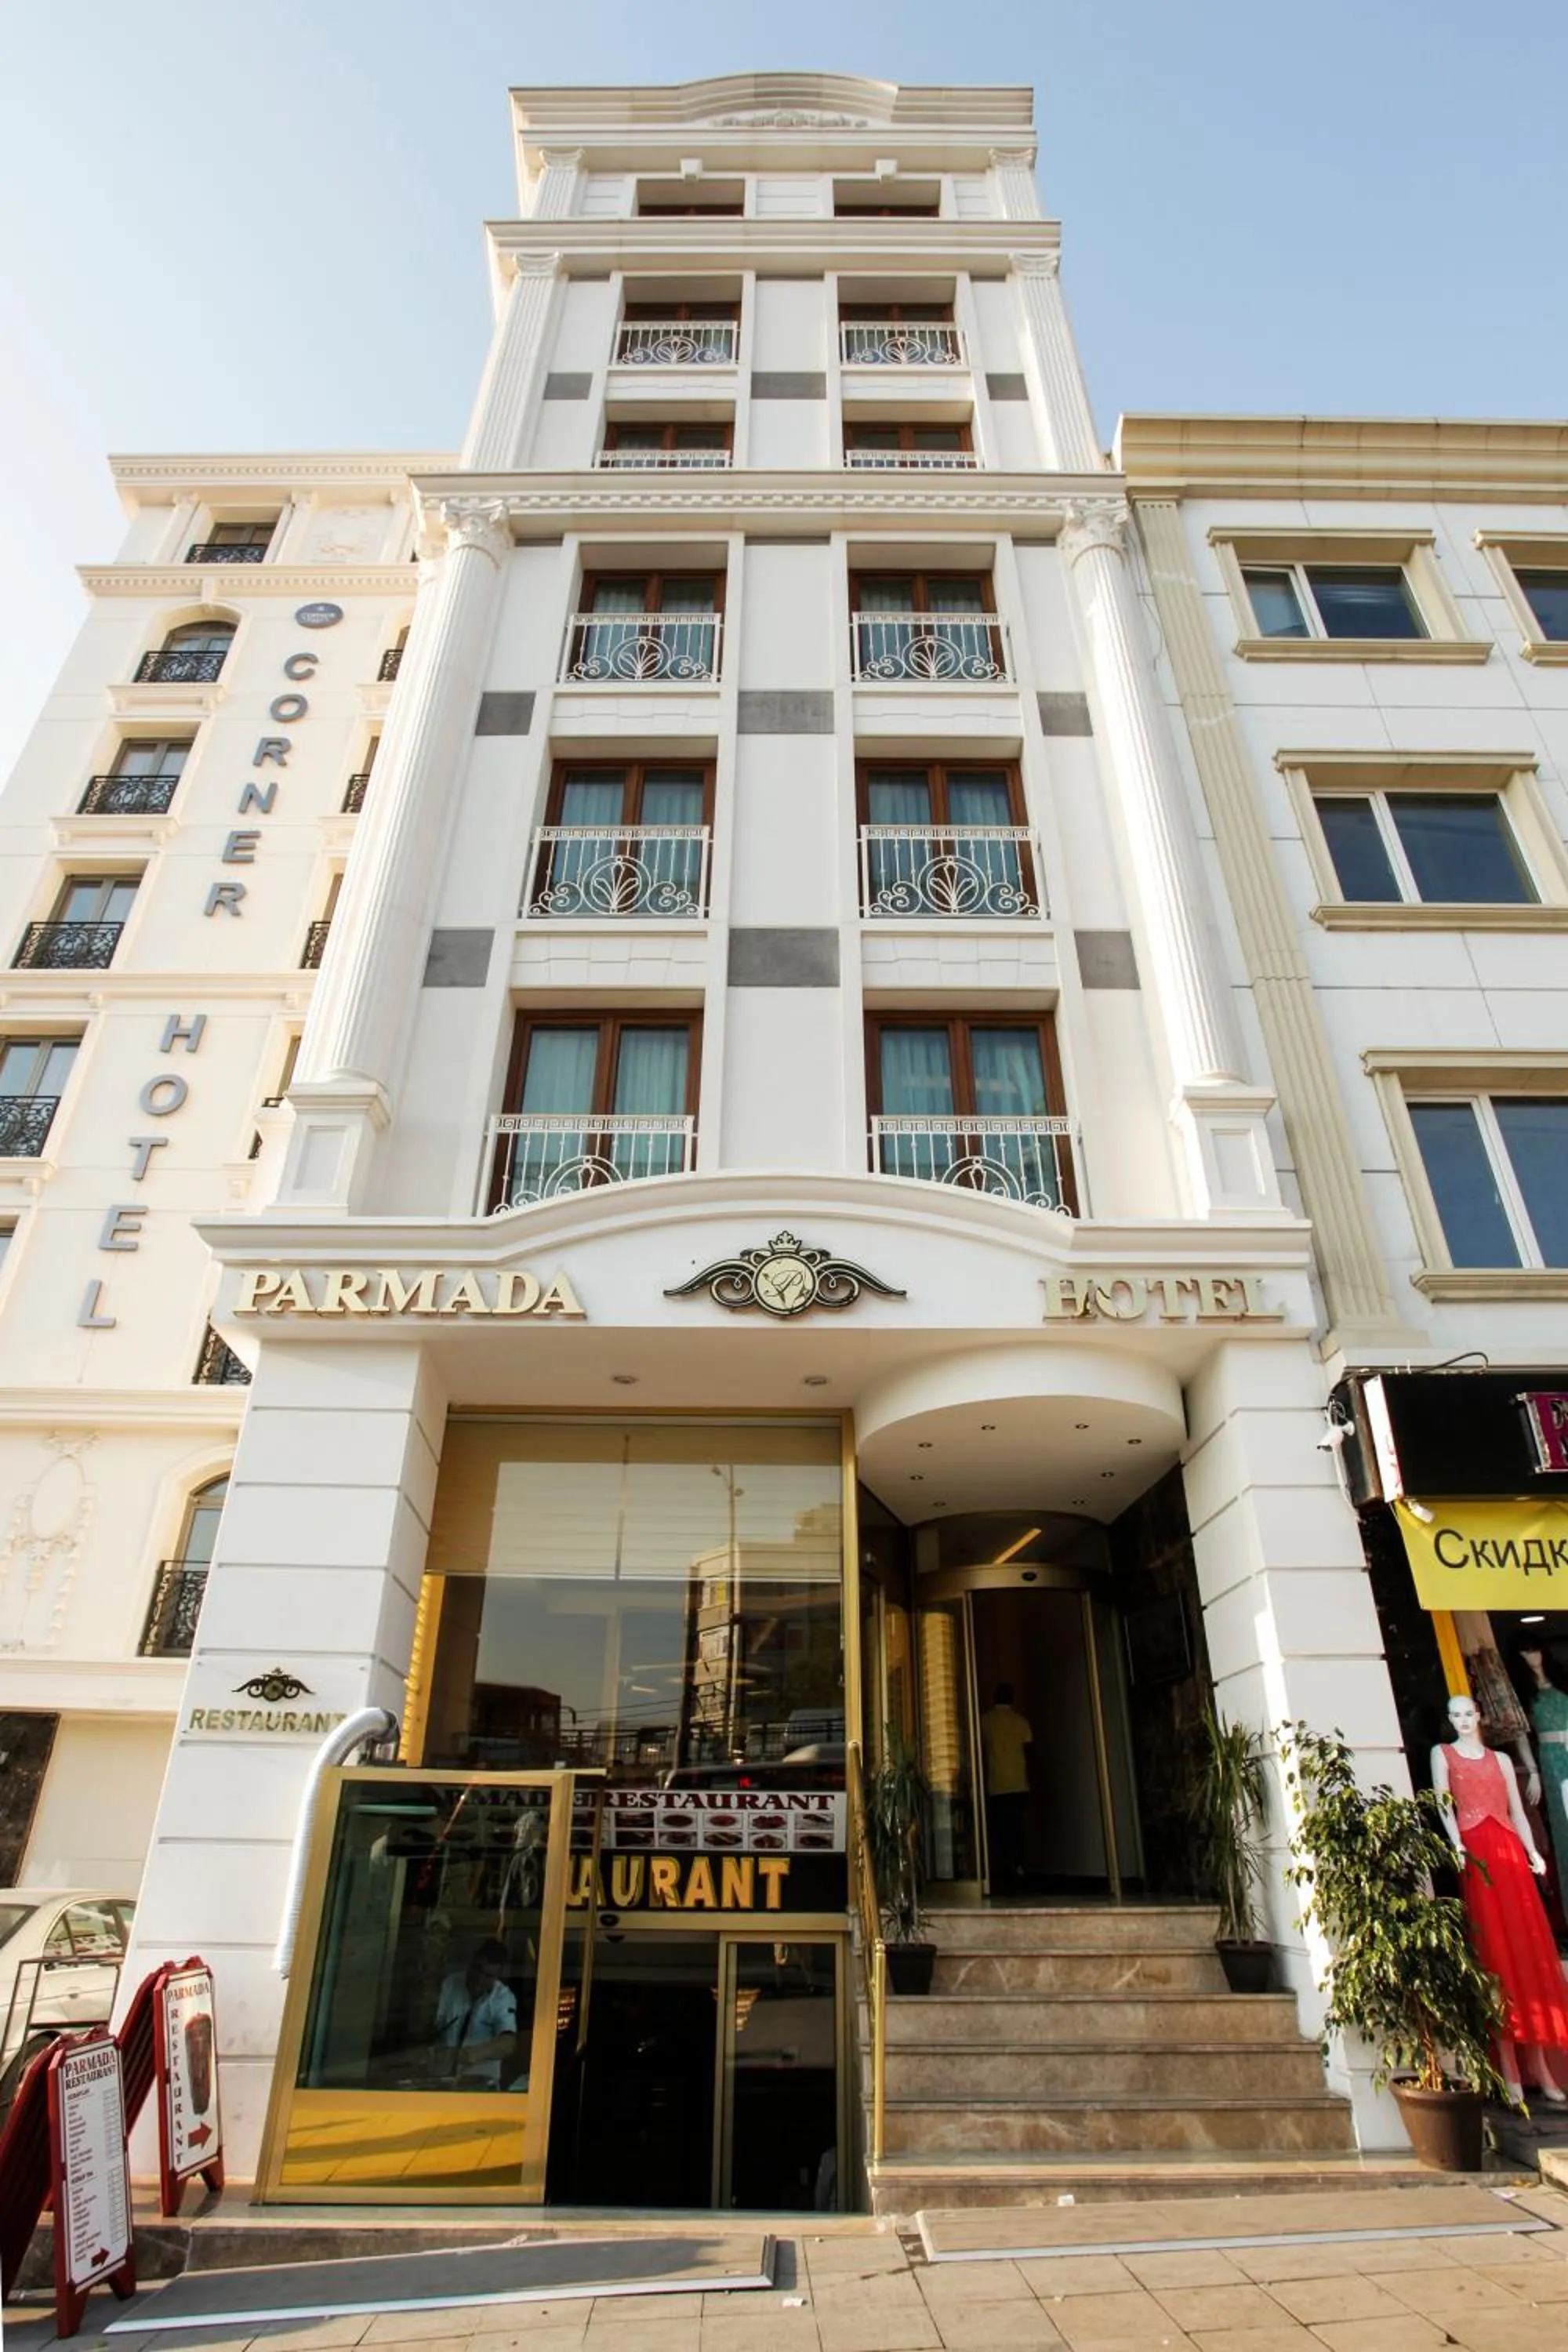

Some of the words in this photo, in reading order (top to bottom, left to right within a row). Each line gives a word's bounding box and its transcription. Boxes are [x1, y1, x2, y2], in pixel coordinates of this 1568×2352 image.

[204, 652, 318, 916] CORNER
[78, 1014, 208, 1329] HOTEL
[233, 1268, 587, 1318] PARMADA
[1037, 1276, 1286, 1320] HOTEL
[1434, 1528, 1568, 1577] Скидк
[64, 2050, 115, 2078] PARMADA
[65, 2063, 117, 2090] RESTAURANT
